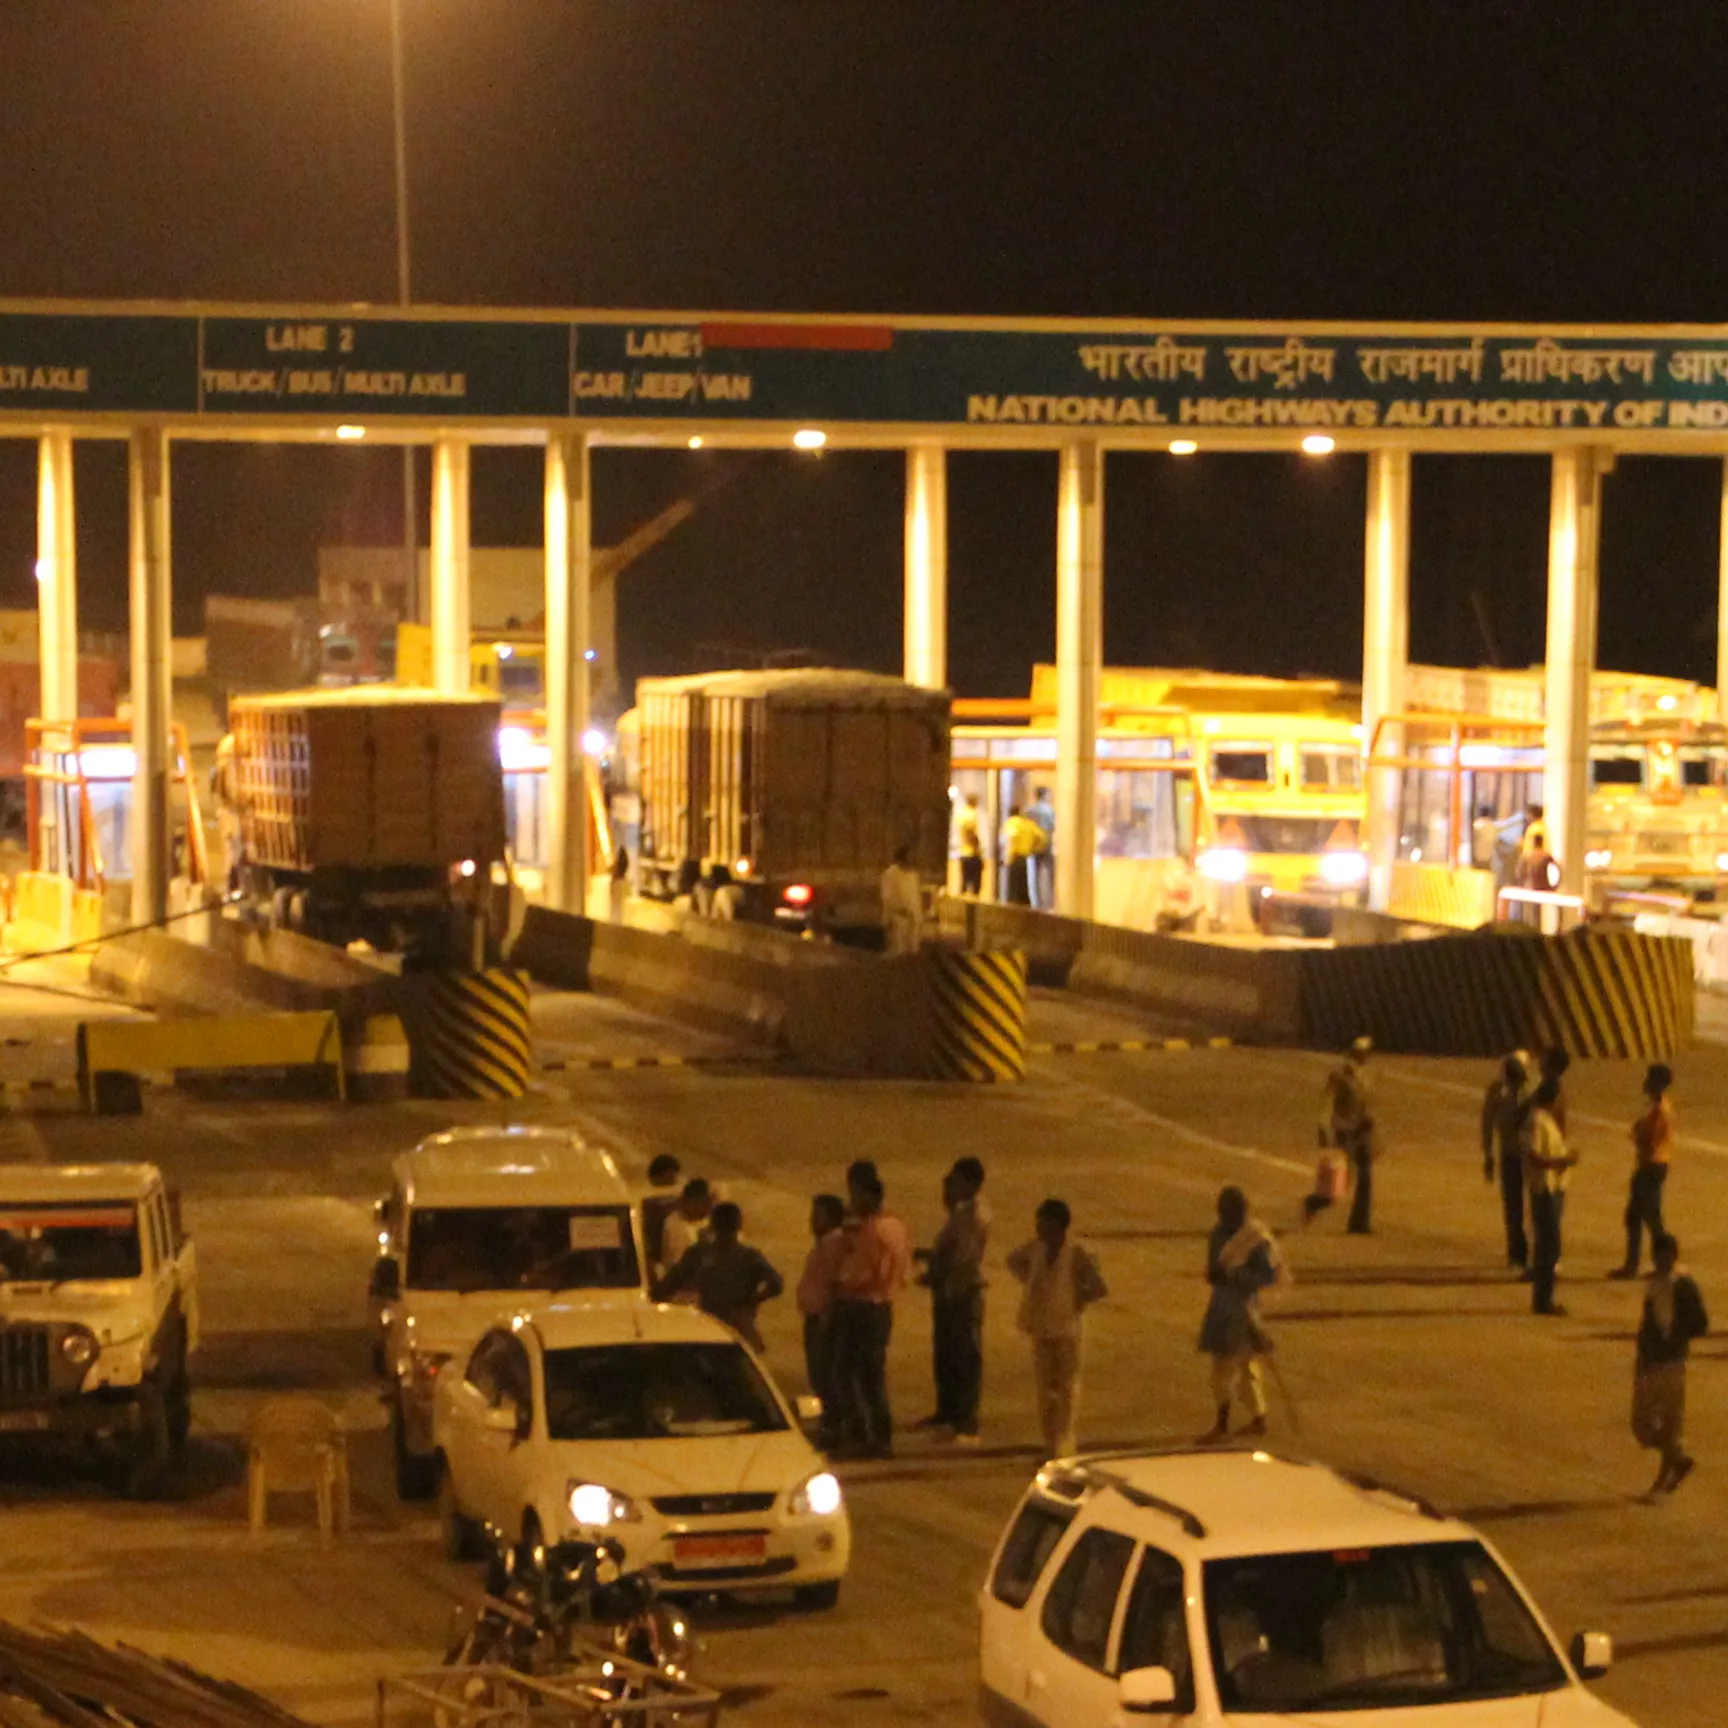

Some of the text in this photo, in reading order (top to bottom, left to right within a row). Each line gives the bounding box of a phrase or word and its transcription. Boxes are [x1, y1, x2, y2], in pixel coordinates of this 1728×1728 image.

[265, 325, 354, 352] LANE 2
[1079, 336, 1206, 383] भारतीय
[967, 396, 1168, 424] NATIONAL
[1179, 397, 1377, 427] HIGHWAYS
[1384, 399, 1608, 428] AUTHORITY
[1612, 401, 1662, 428] OF
